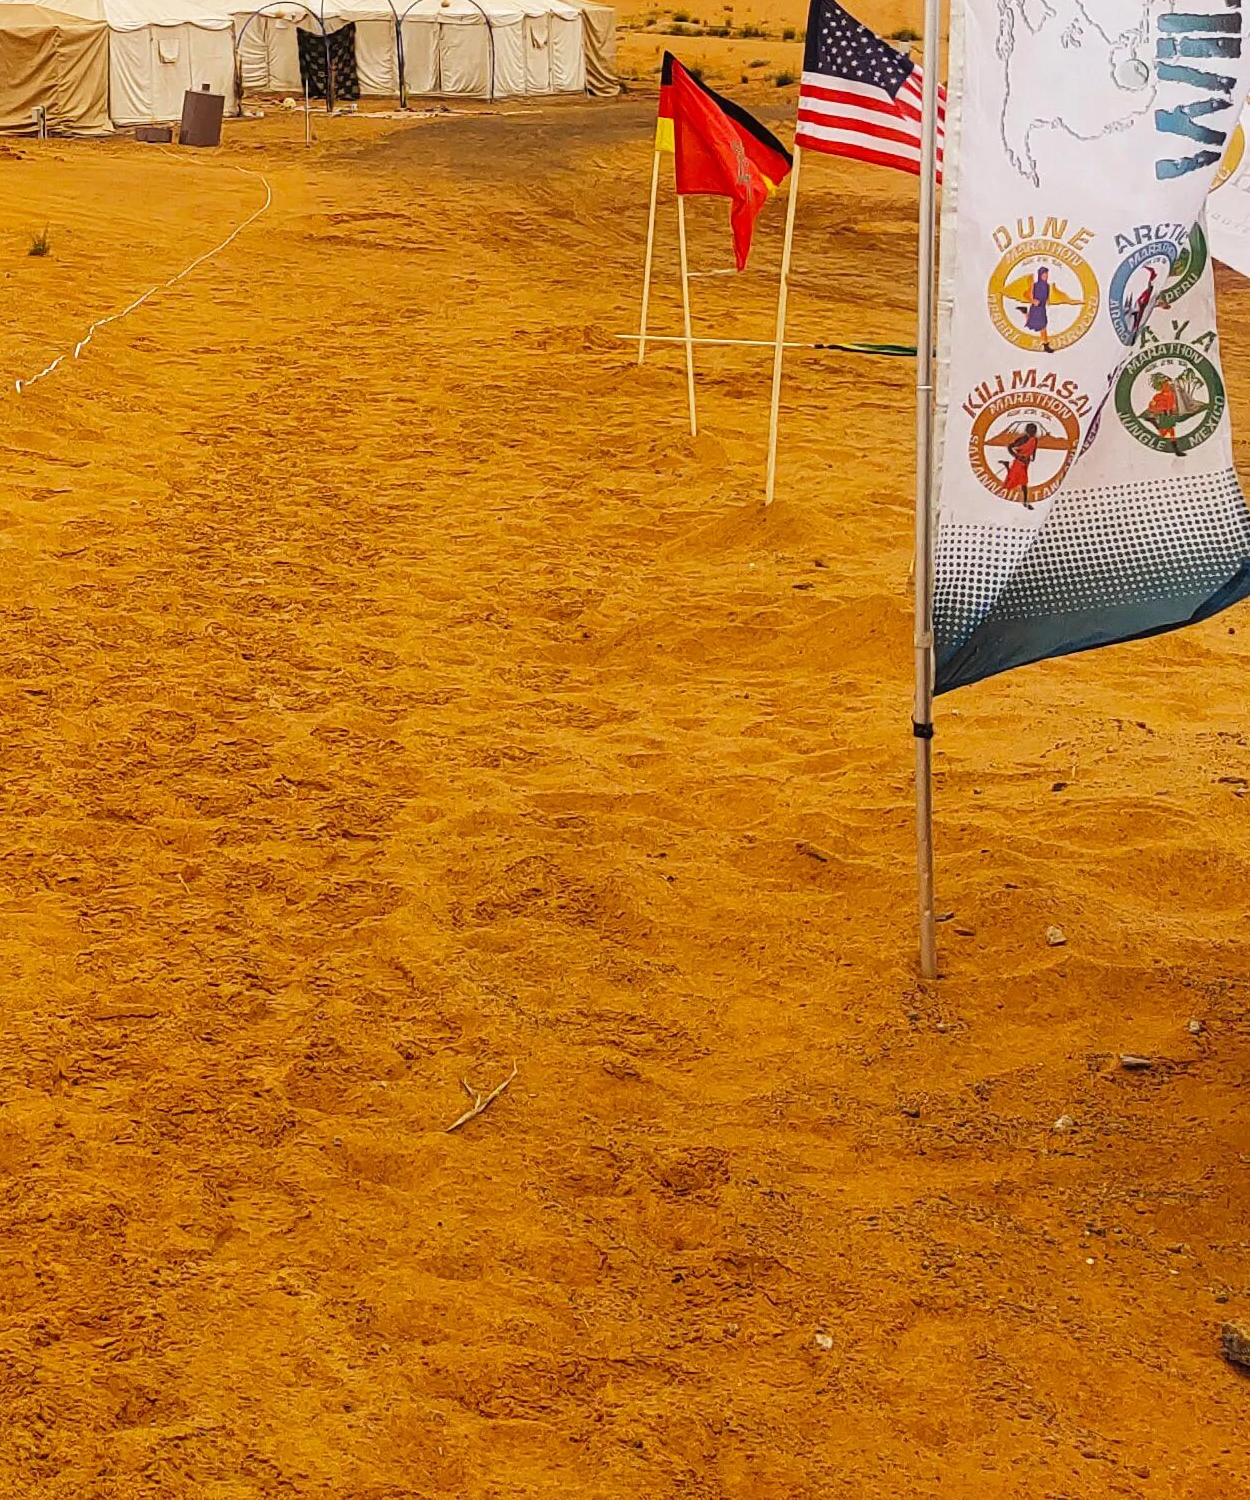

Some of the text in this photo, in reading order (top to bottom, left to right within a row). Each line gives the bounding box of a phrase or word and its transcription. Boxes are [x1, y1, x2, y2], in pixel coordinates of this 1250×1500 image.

[992, 216, 1097, 252] DUNE
[1164, 271, 1199, 304] PERU
[1126, 343, 1204, 375] MARATHON
[990, 392, 1072, 420] MARATHON
[1117, 411, 1167, 451] JUNGLE
[1189, 395, 1225, 448] MEXICO
